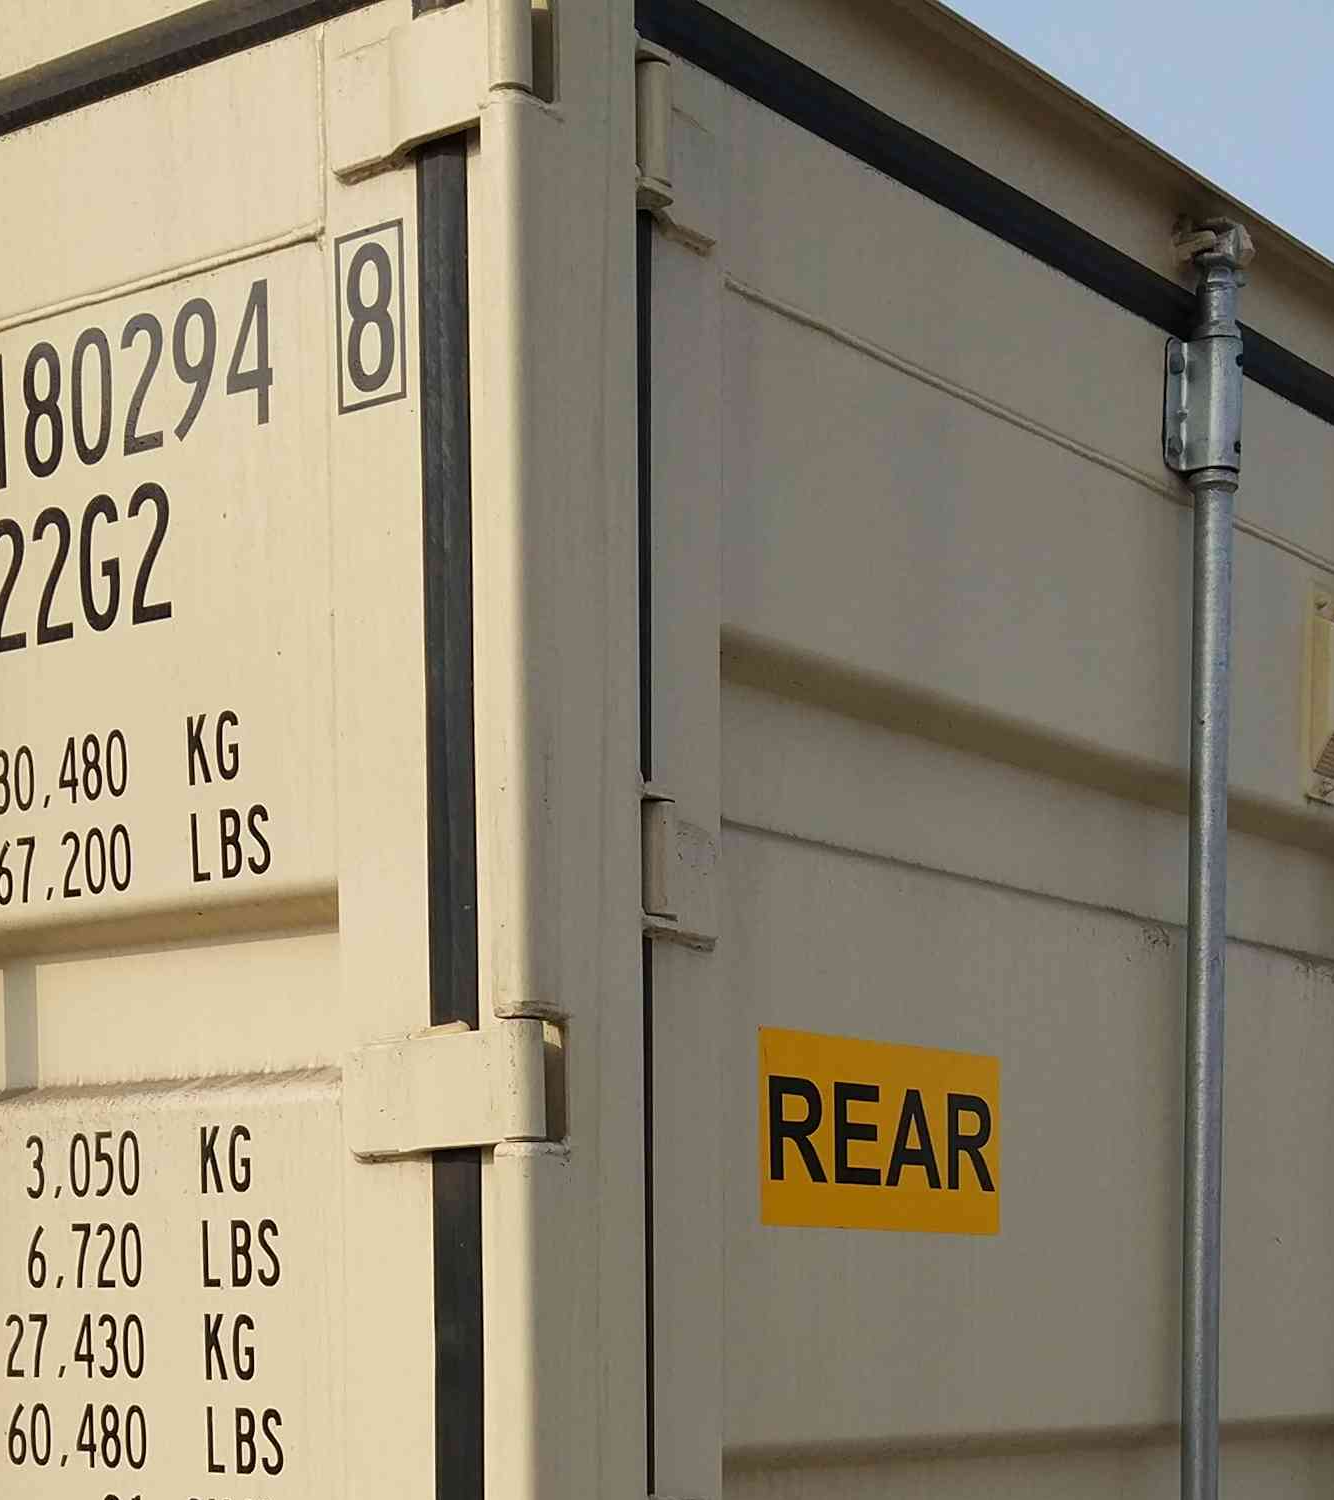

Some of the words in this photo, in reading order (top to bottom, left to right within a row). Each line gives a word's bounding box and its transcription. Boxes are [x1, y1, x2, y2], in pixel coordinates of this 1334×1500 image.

[345, 241, 397, 394] 8
[186, 710, 241, 787] KG
[190, 804, 272, 884] LBS
[25, 1130, 141, 1200] 3,050
[199, 1125, 252, 1195] KG
[767, 1074, 997, 1193] REAR
[26, 1221, 143, 1290] 6,720
[201, 1218, 282, 1290] LBS
[4, 1313, 146, 1380] 27,430
[204, 1313, 256, 1381] KG
[6, 1403, 148, 1470] 60,480
[206, 1407, 286, 1477] LBS
